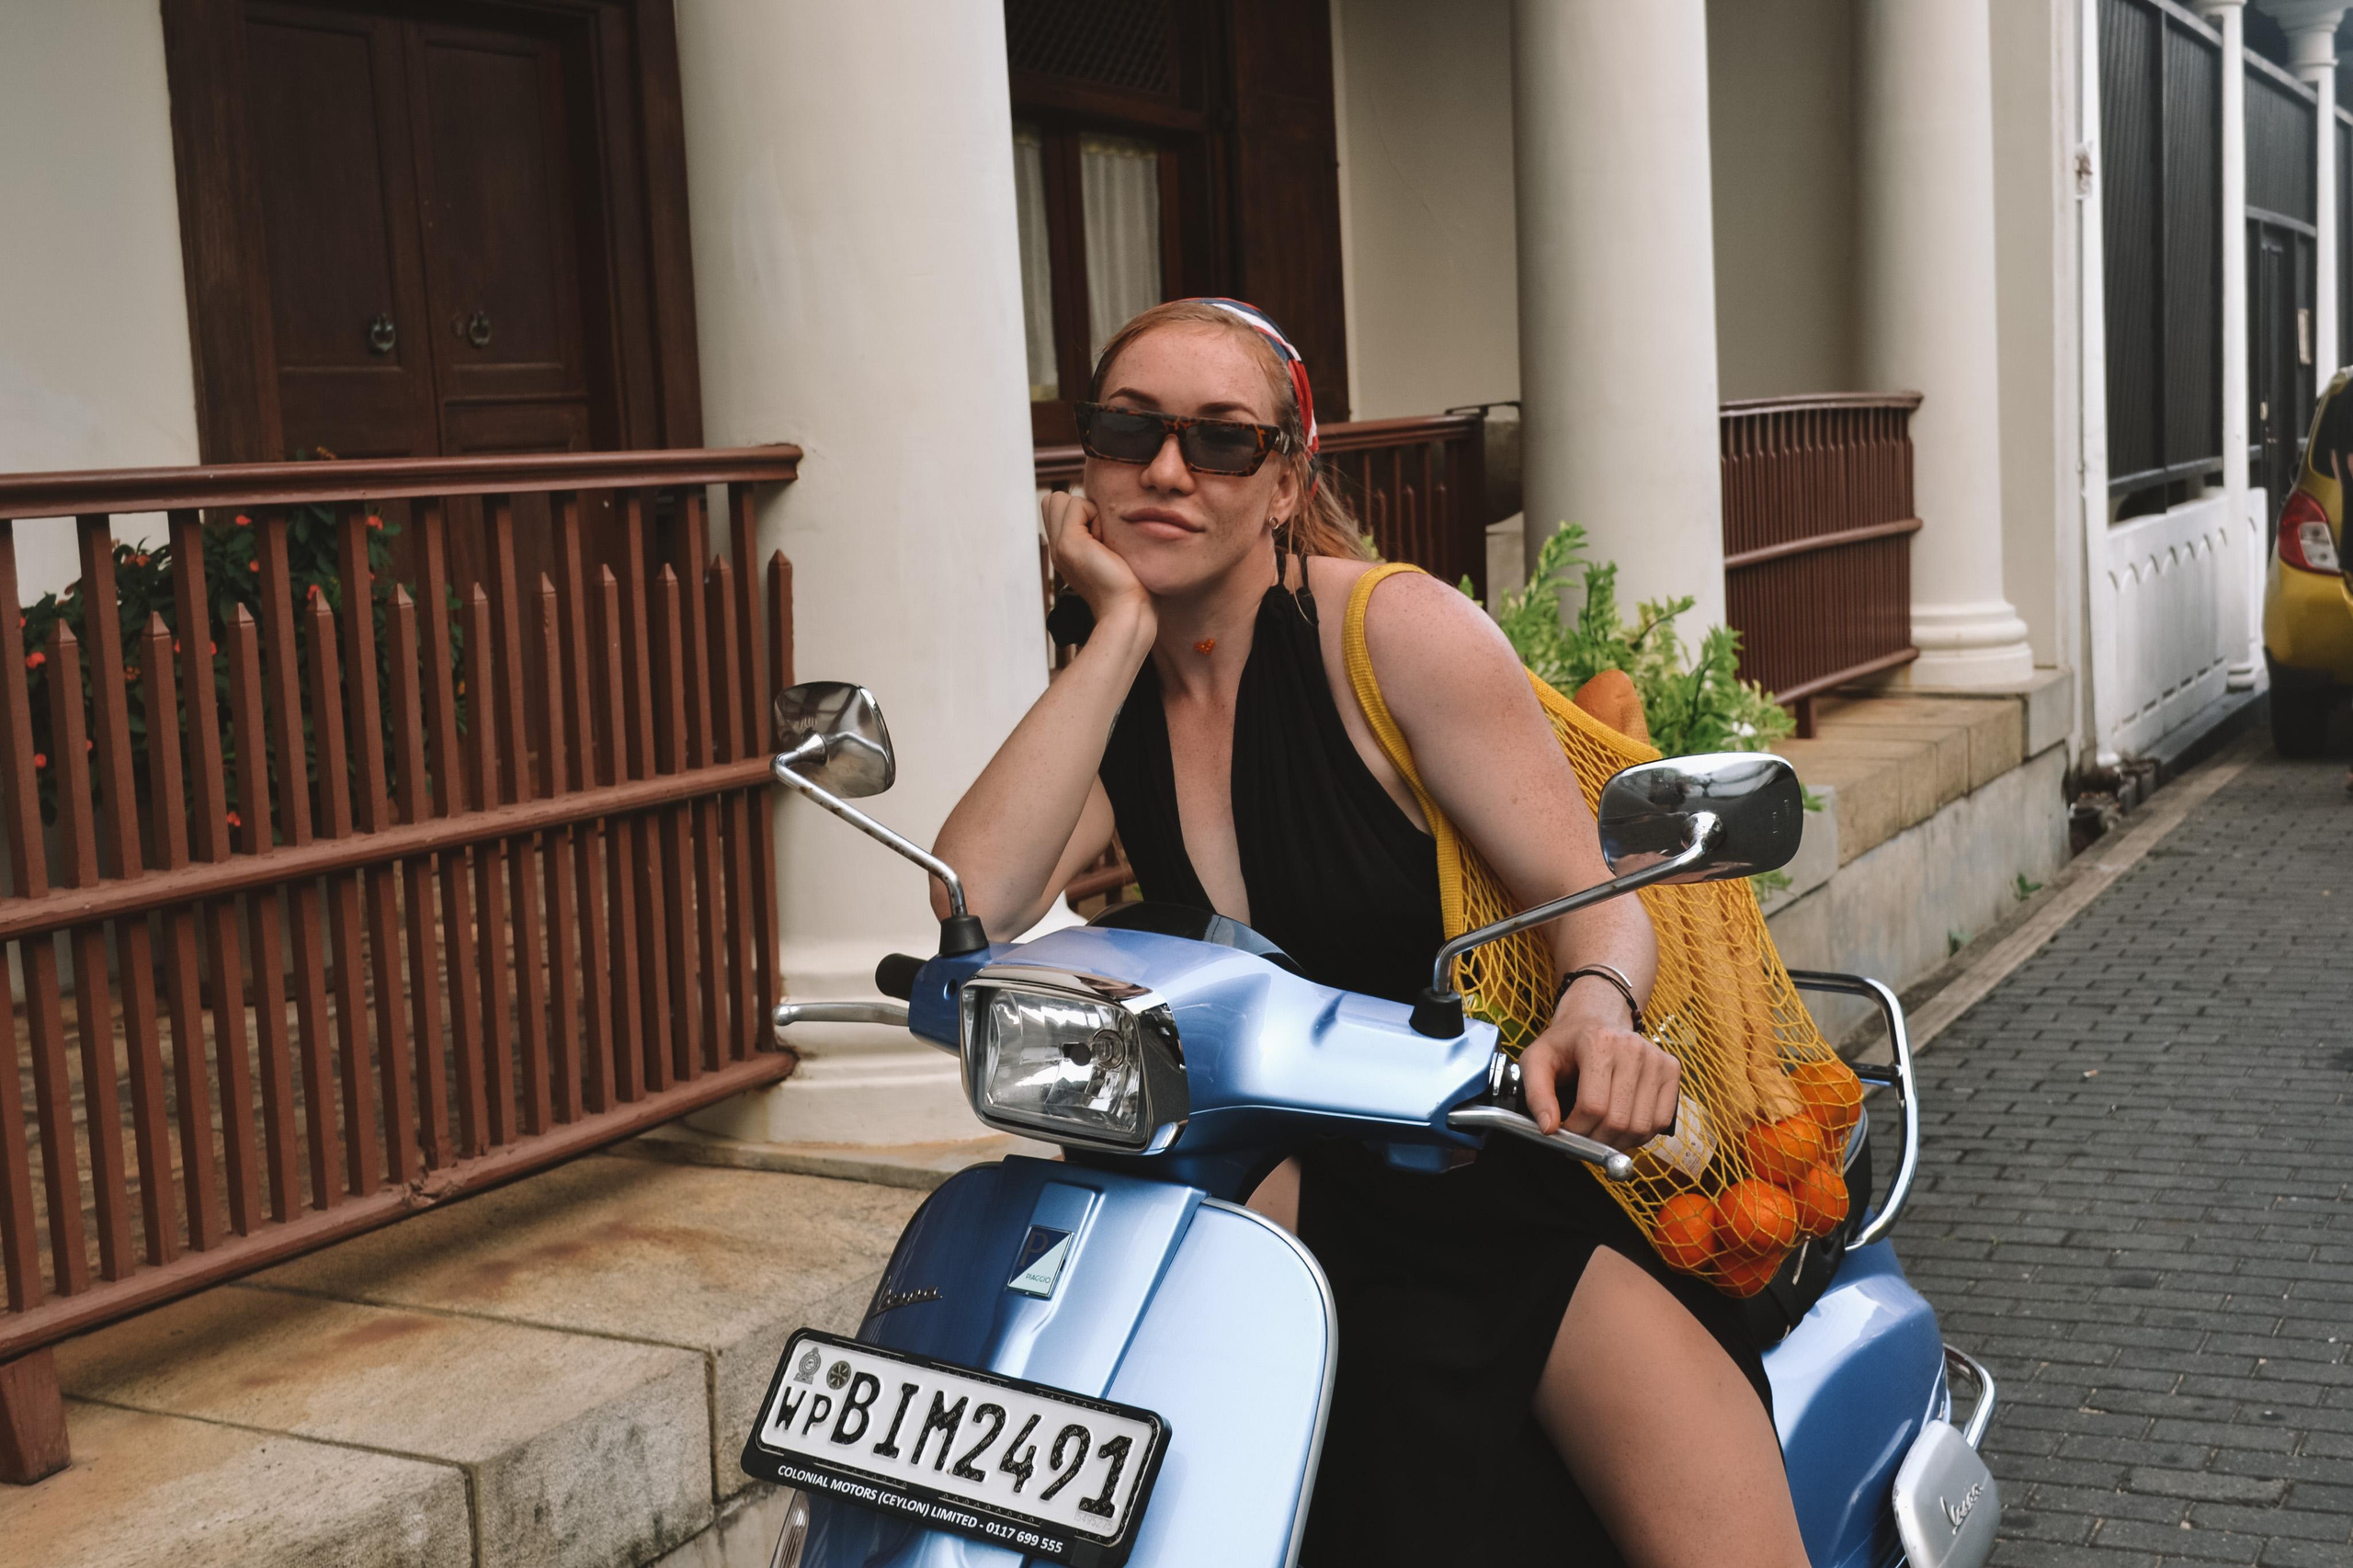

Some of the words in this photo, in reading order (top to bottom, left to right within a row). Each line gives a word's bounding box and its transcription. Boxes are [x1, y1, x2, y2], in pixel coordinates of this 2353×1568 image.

[1018, 1232, 1049, 1267] P
[1025, 1273, 1051, 1284] PIAGGIO
[774, 1386, 832, 1436] WP
[830, 1371, 1133, 1518] BIM2491
[778, 1465, 828, 1488] COLONIAL
[830, 1479, 878, 1500] MOTORS
[878, 1491, 930, 1517] (CEYLON)
[930, 1506, 978, 1528] LIMITED
[985, 1522, 1016, 1540] 0117
[1017, 1530, 1040, 1547] 699
[1040, 1538, 1063, 1553] 555
[1940, 1483, 1984, 1535] Vespa
